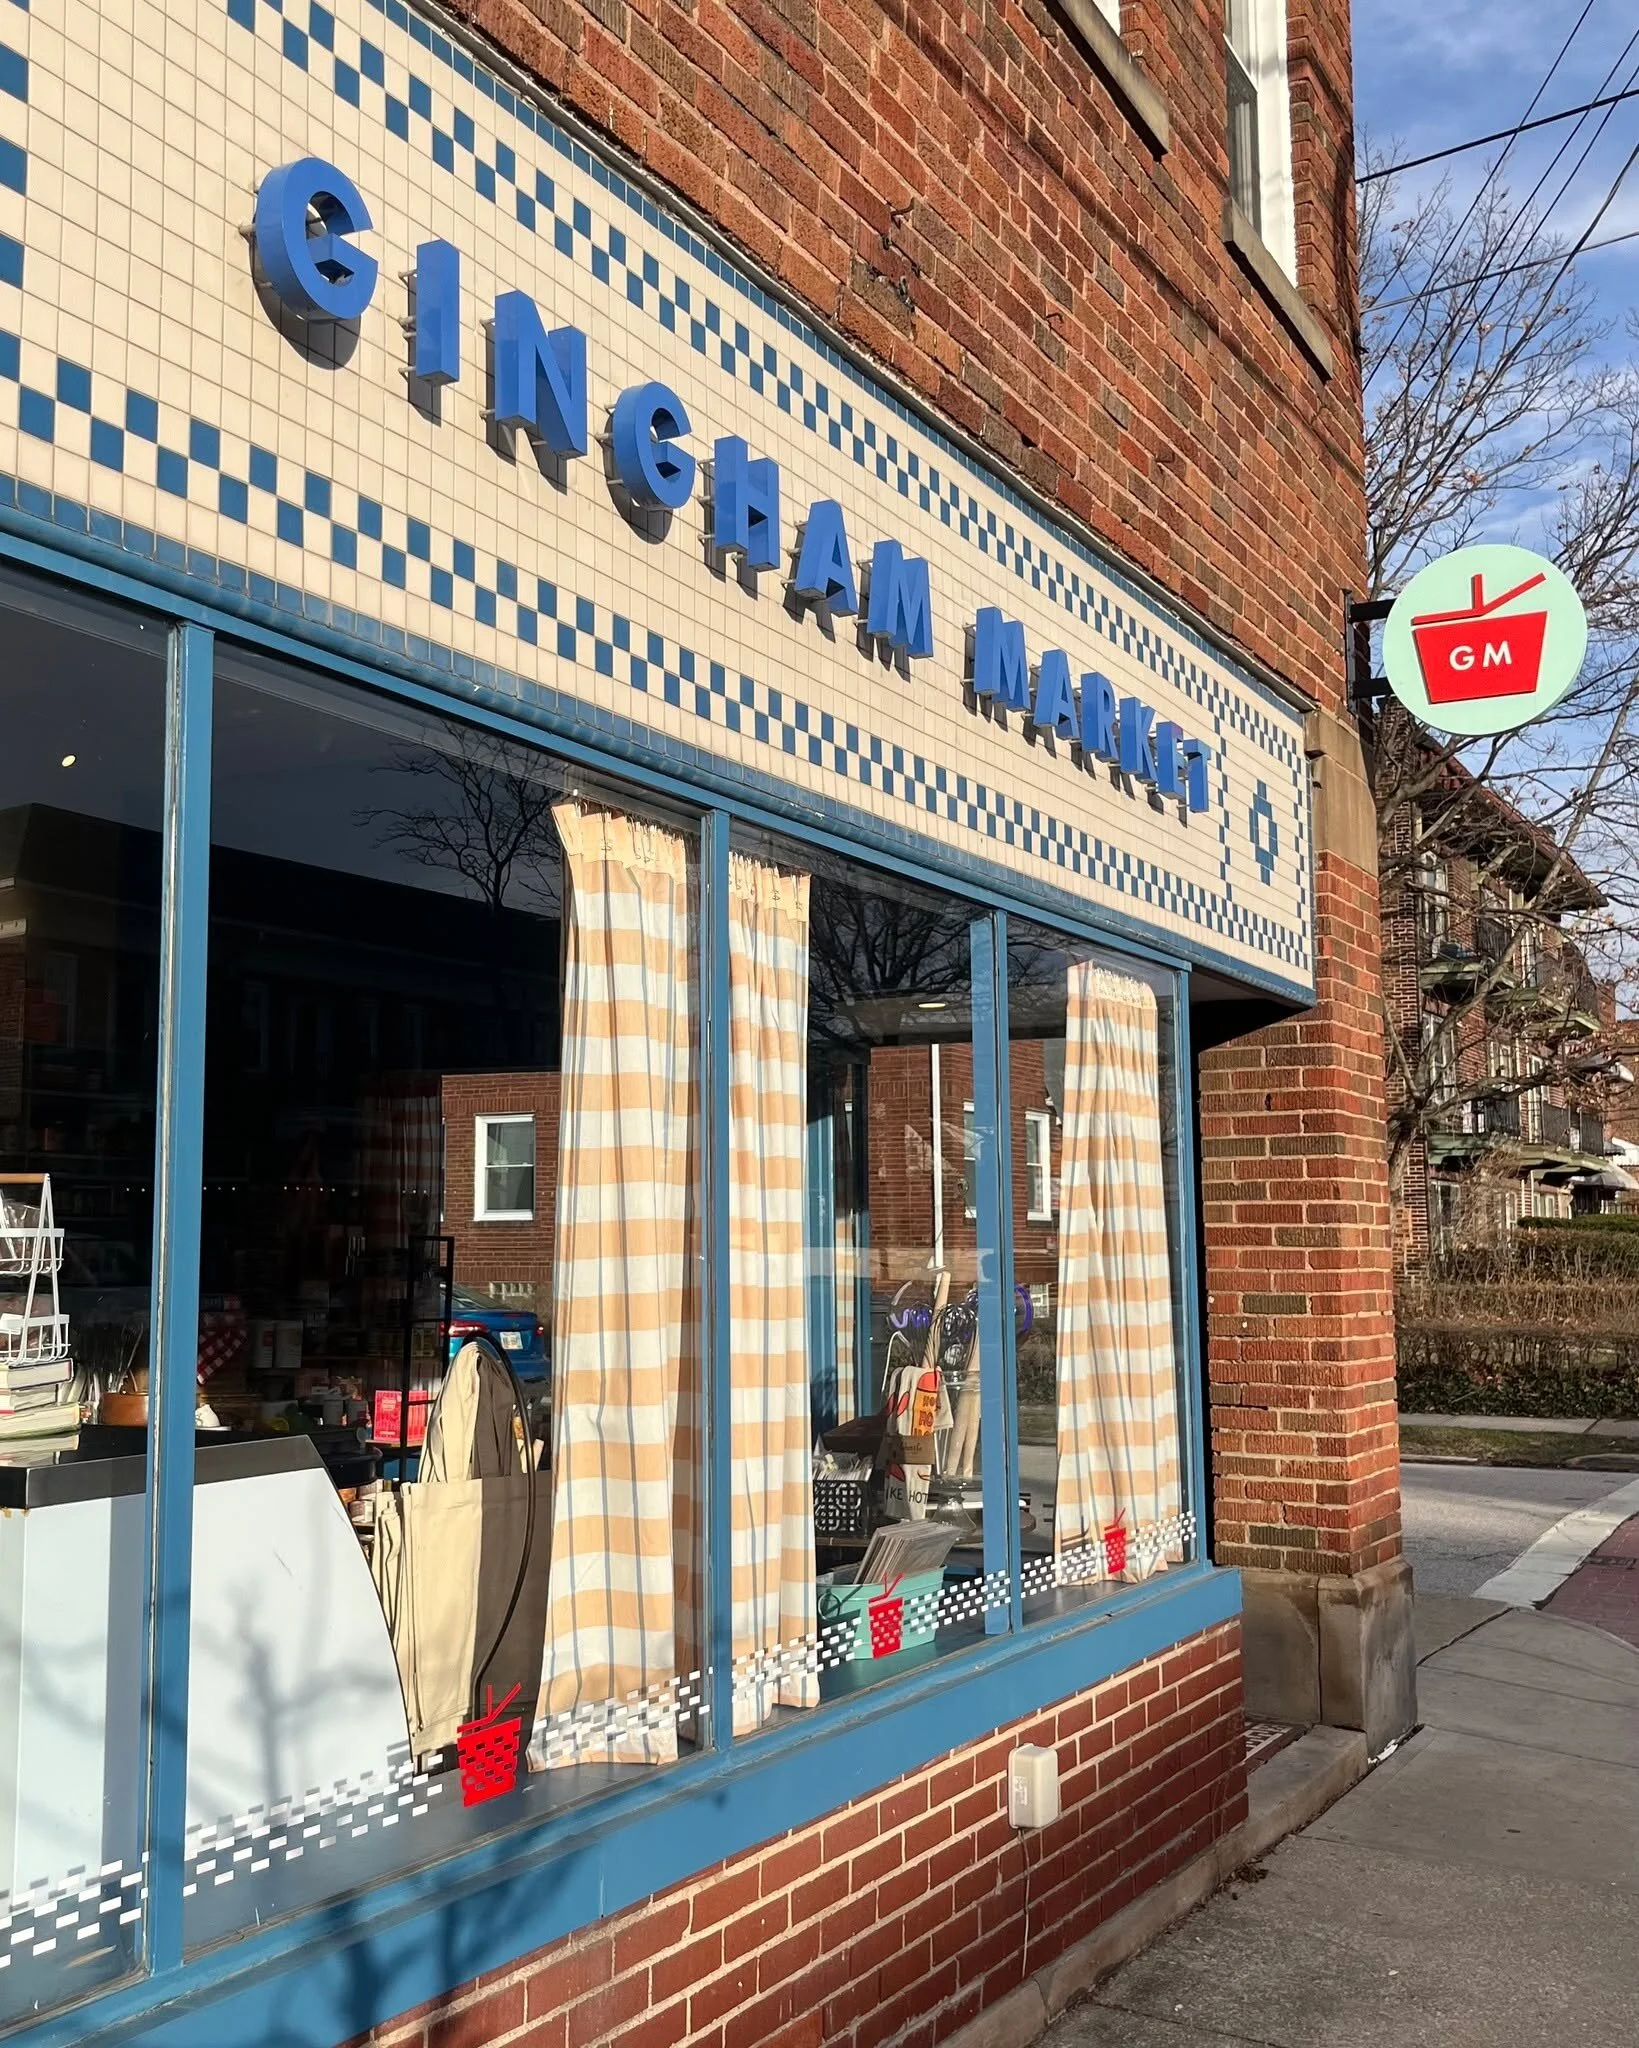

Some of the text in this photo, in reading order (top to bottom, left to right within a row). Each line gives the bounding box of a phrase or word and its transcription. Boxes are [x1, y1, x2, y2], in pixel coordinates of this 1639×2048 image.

[255, 156, 1211, 813] GINGHAM MARKET
[1449, 640, 1512, 671] GM
